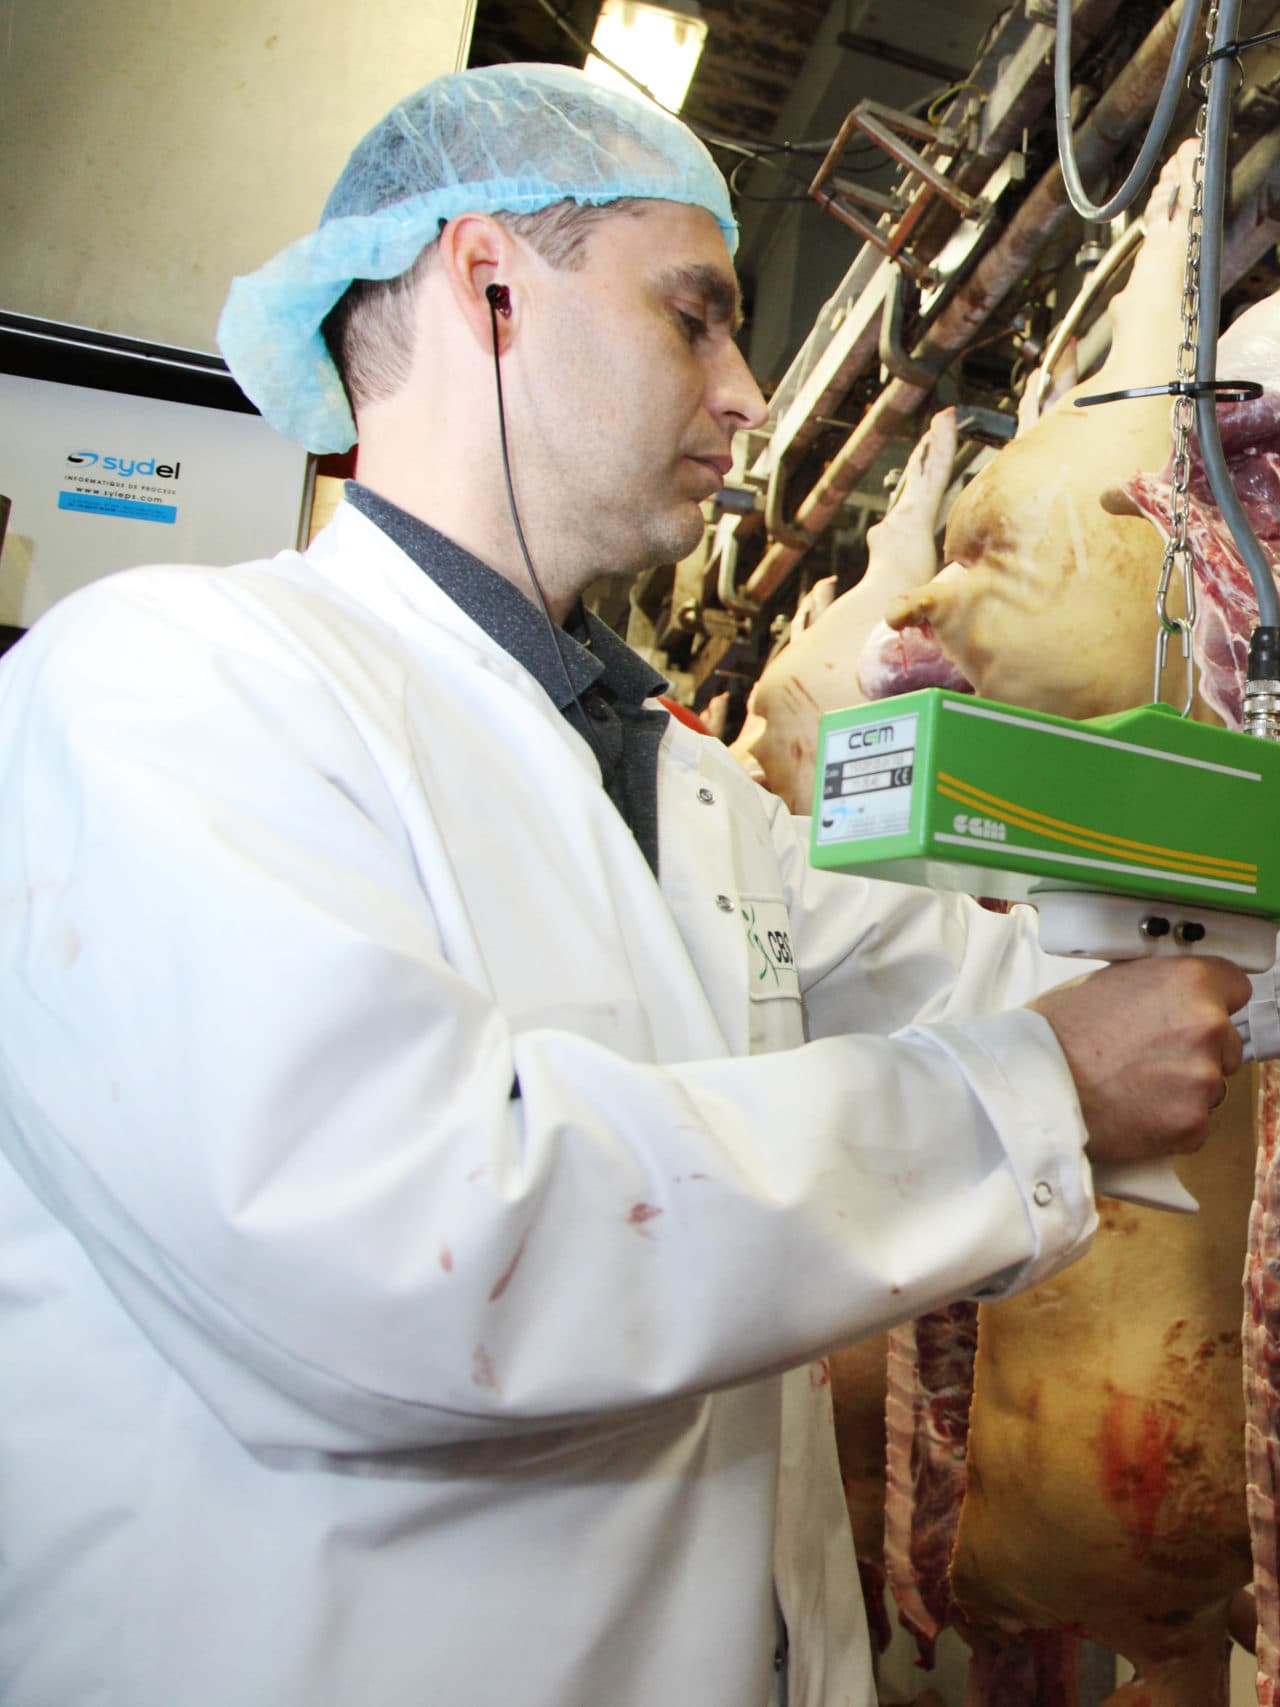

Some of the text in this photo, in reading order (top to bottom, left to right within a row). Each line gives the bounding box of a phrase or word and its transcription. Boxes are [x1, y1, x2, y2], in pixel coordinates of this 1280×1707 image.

[103, 456, 180, 479] sydel
[65, 475, 124, 488] INFORMATIQUE
[141, 485, 176, 496] PROCESS
